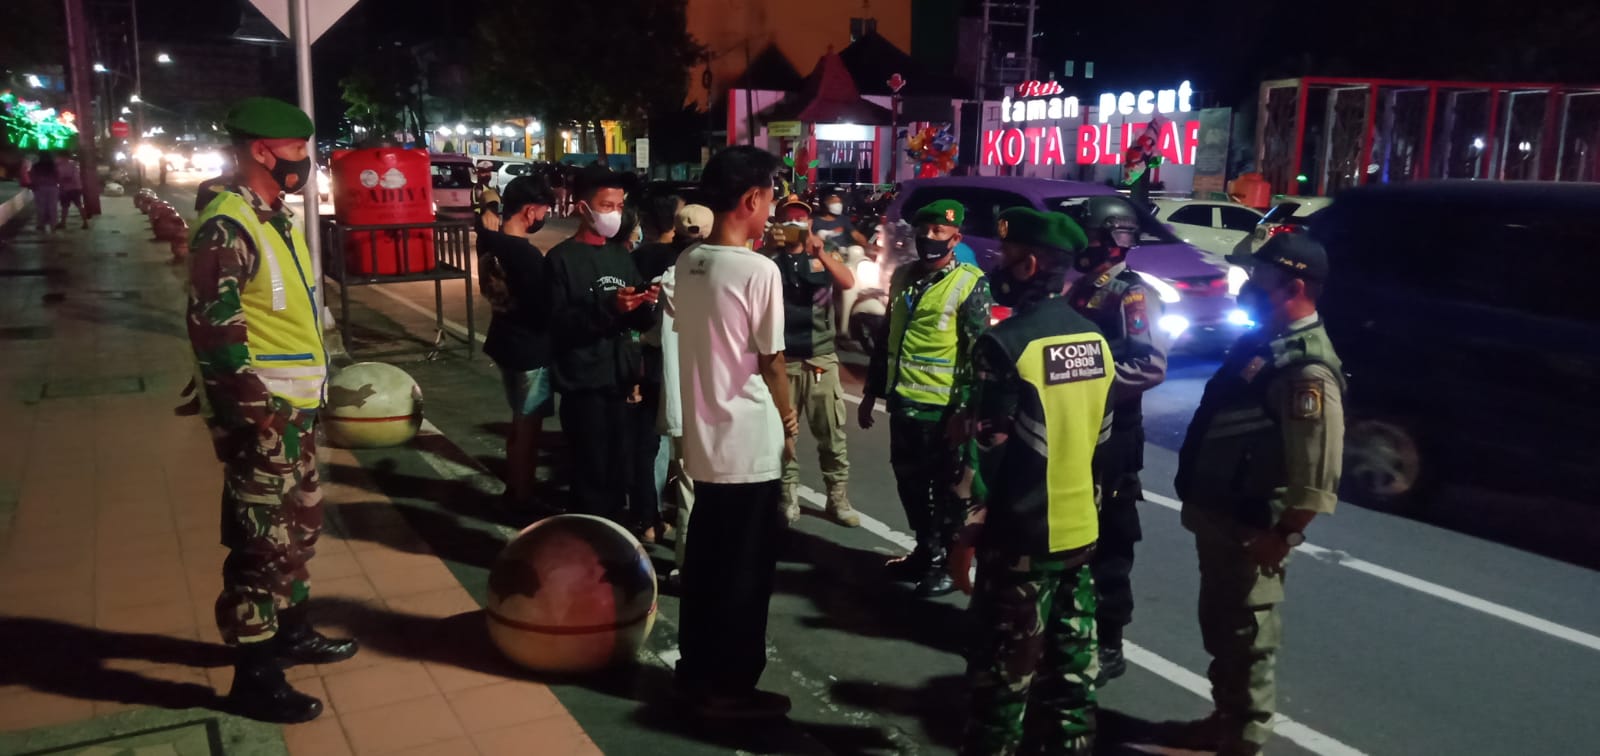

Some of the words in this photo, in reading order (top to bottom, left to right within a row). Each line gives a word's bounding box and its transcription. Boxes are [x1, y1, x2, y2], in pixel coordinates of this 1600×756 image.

[1001, 95, 1079, 122] taman
[1099, 80, 1193, 123] pecut
[983, 126, 1066, 166] KOTA
[1049, 343, 1101, 361] KODIM
[1064, 357, 1095, 369] 0808
